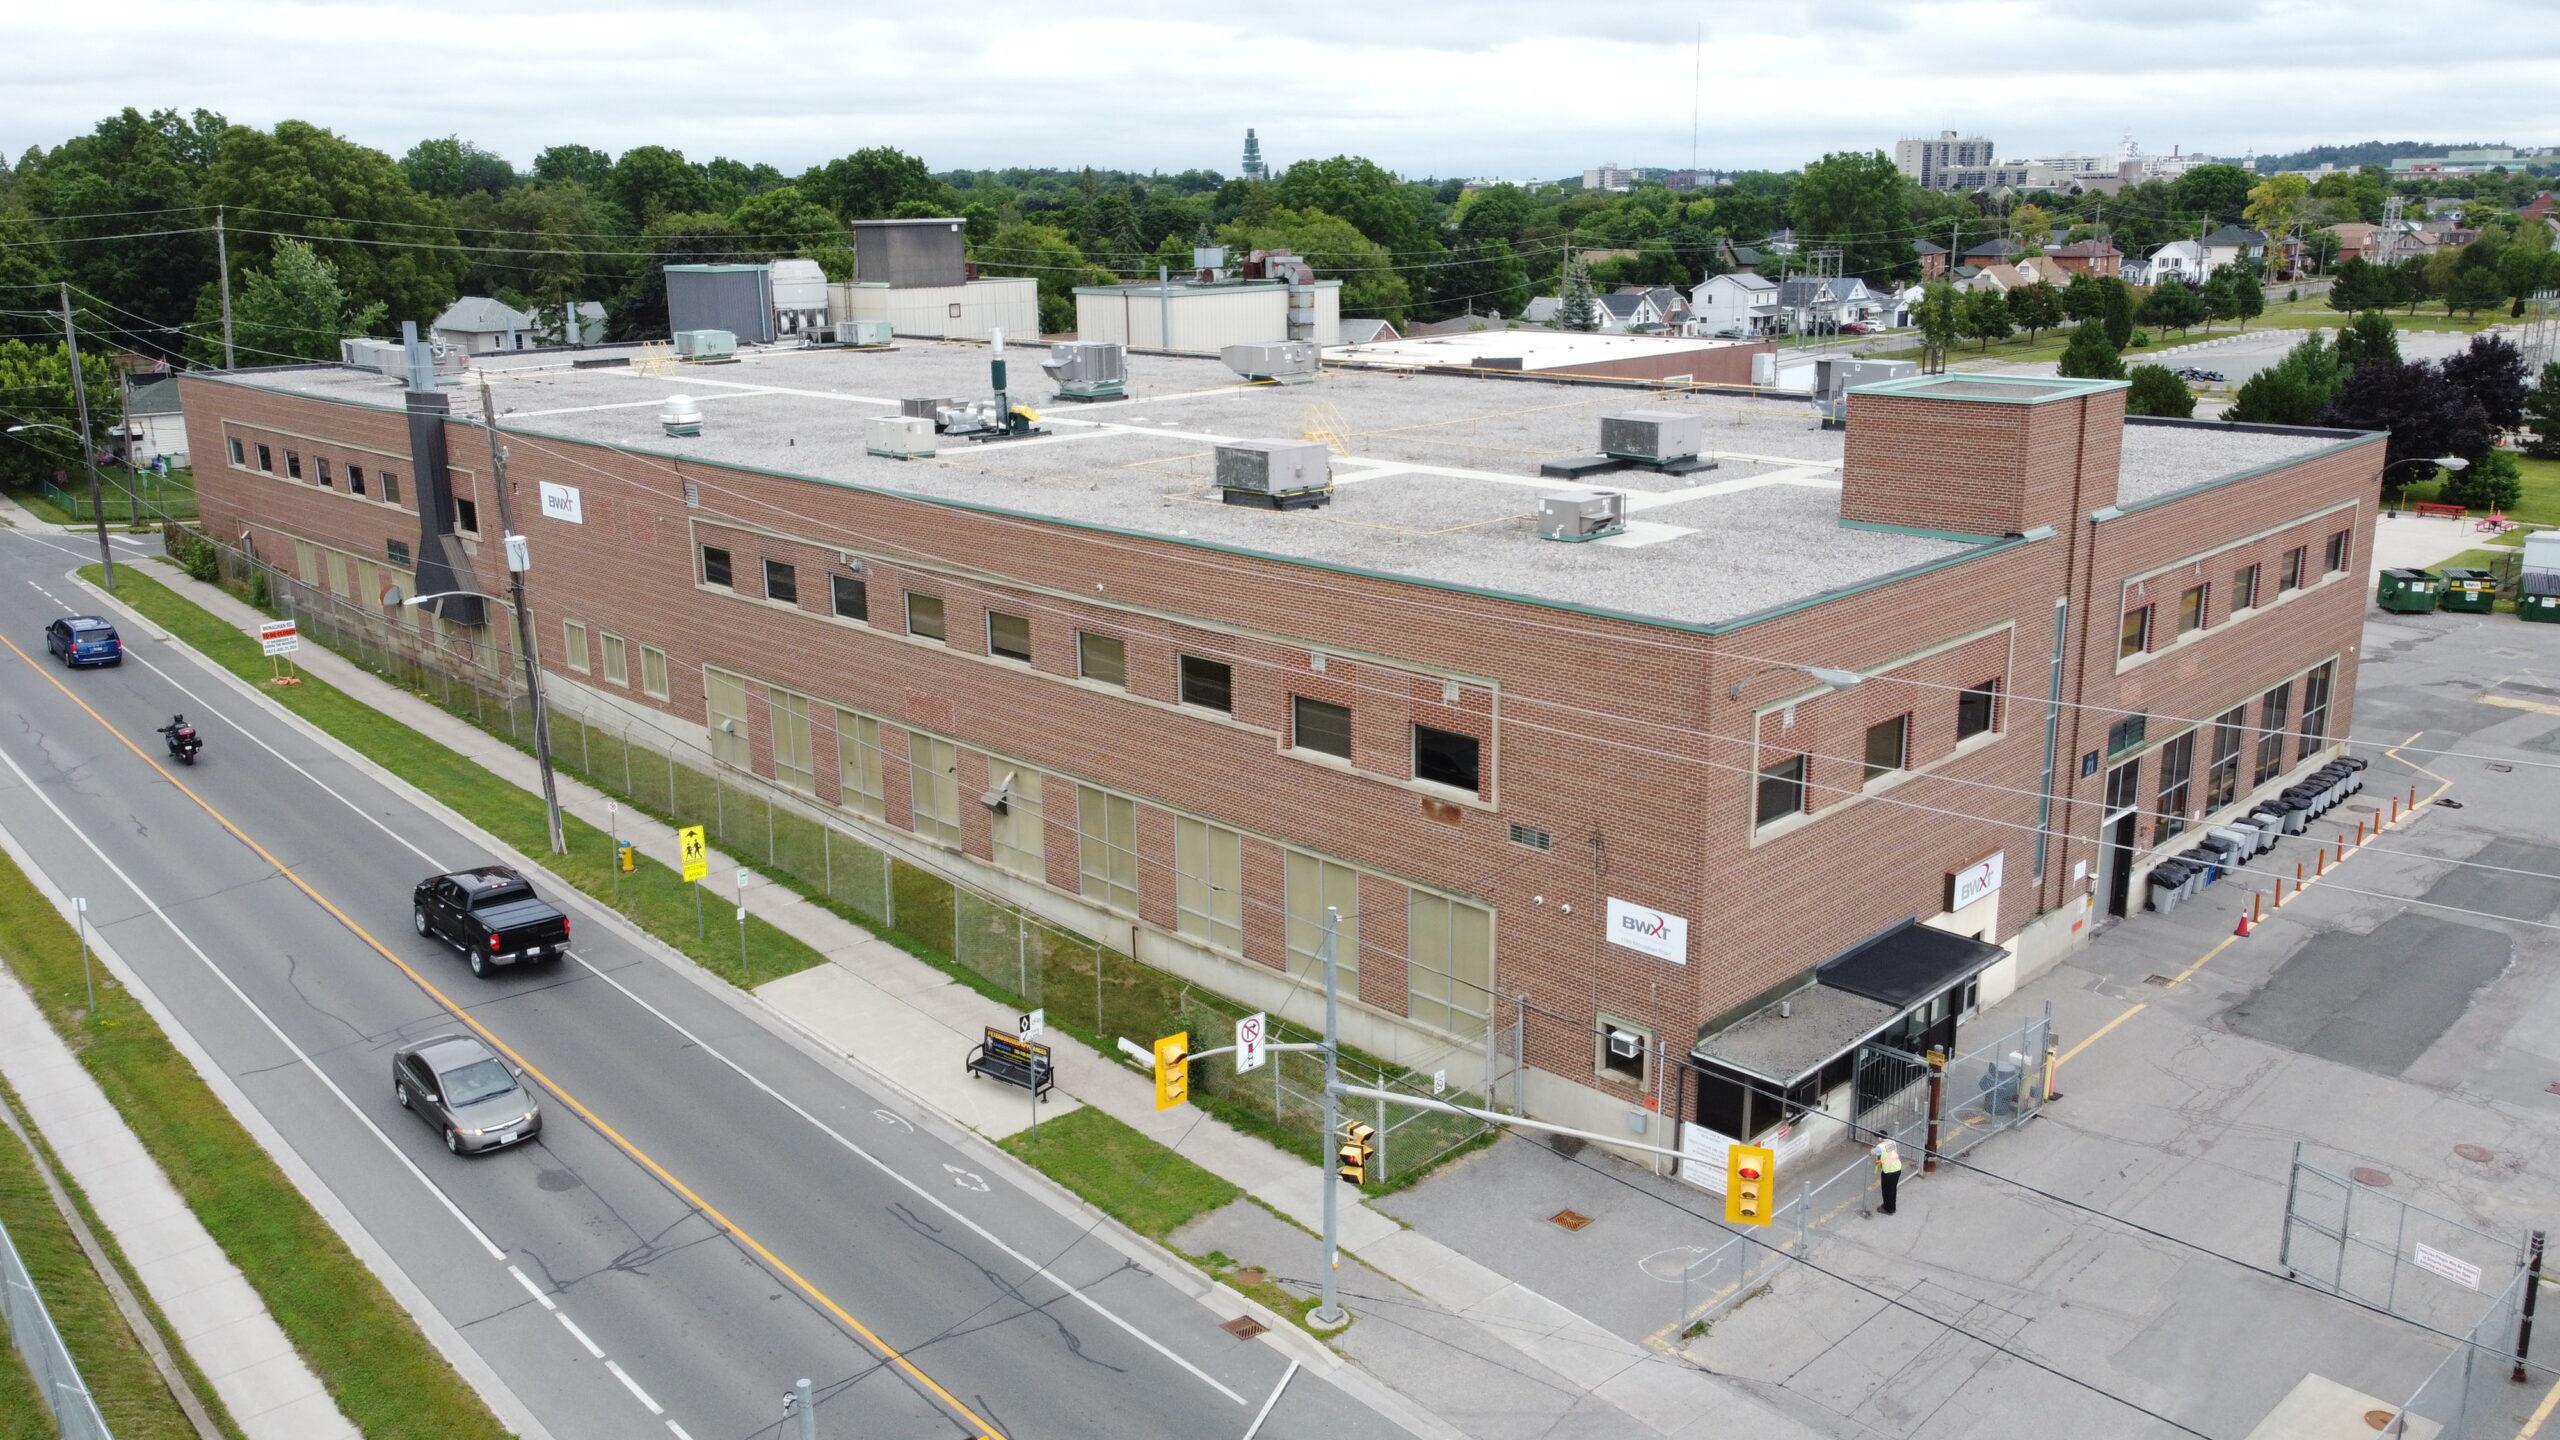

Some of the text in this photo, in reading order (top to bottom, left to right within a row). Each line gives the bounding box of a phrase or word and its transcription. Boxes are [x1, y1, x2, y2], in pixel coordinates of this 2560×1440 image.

[548, 488, 573, 512] BWXT
[262, 628, 296, 640] TO BE CLOSED
[1961, 863, 1994, 901] BWXT
[1622, 912, 1671, 941] BWXT
